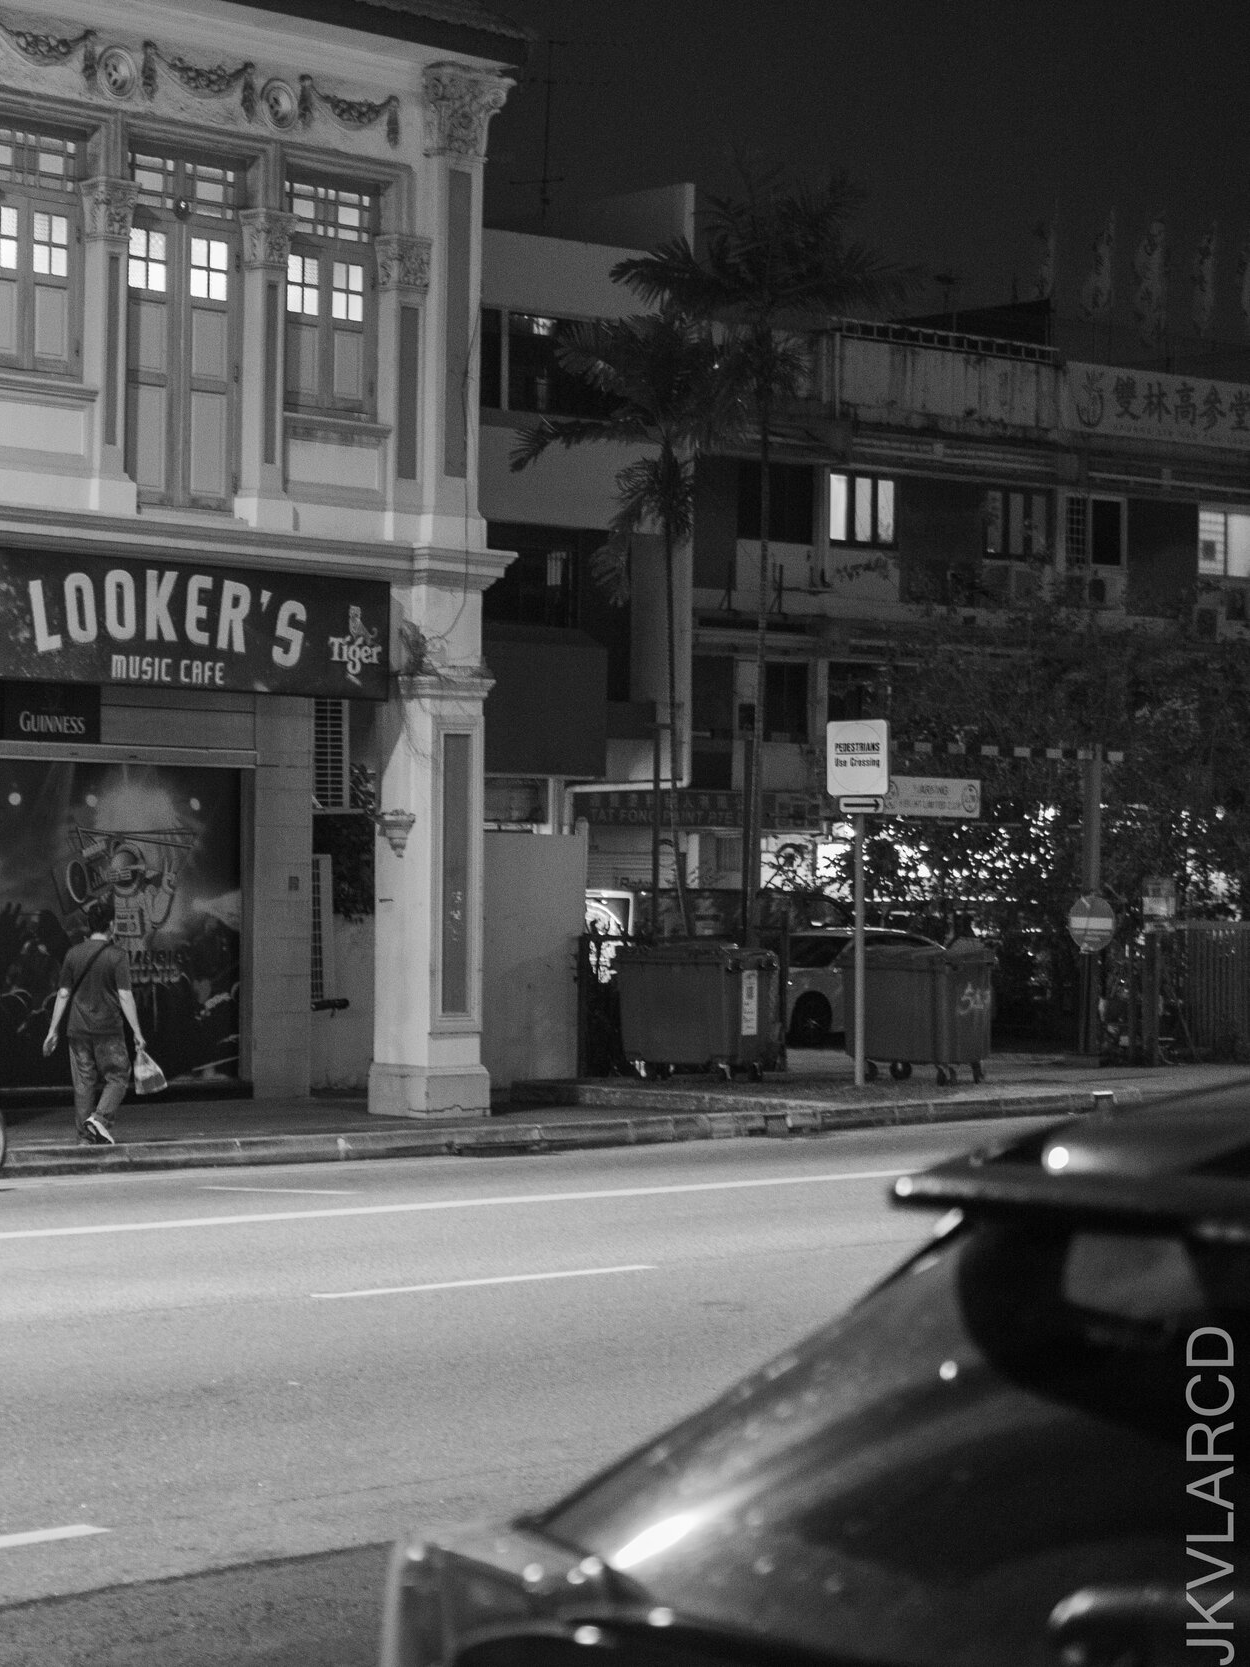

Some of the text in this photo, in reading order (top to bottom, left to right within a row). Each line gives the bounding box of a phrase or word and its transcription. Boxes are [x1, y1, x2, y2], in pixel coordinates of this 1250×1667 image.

[28, 569, 307, 668] LOOKER'S
[111, 654, 225, 685] MUSIC CAFE
[328, 635, 382, 674] Tiger
[834, 742, 880, 752] PEDESTRIANS
[834, 757, 880, 768] Use Crossing
